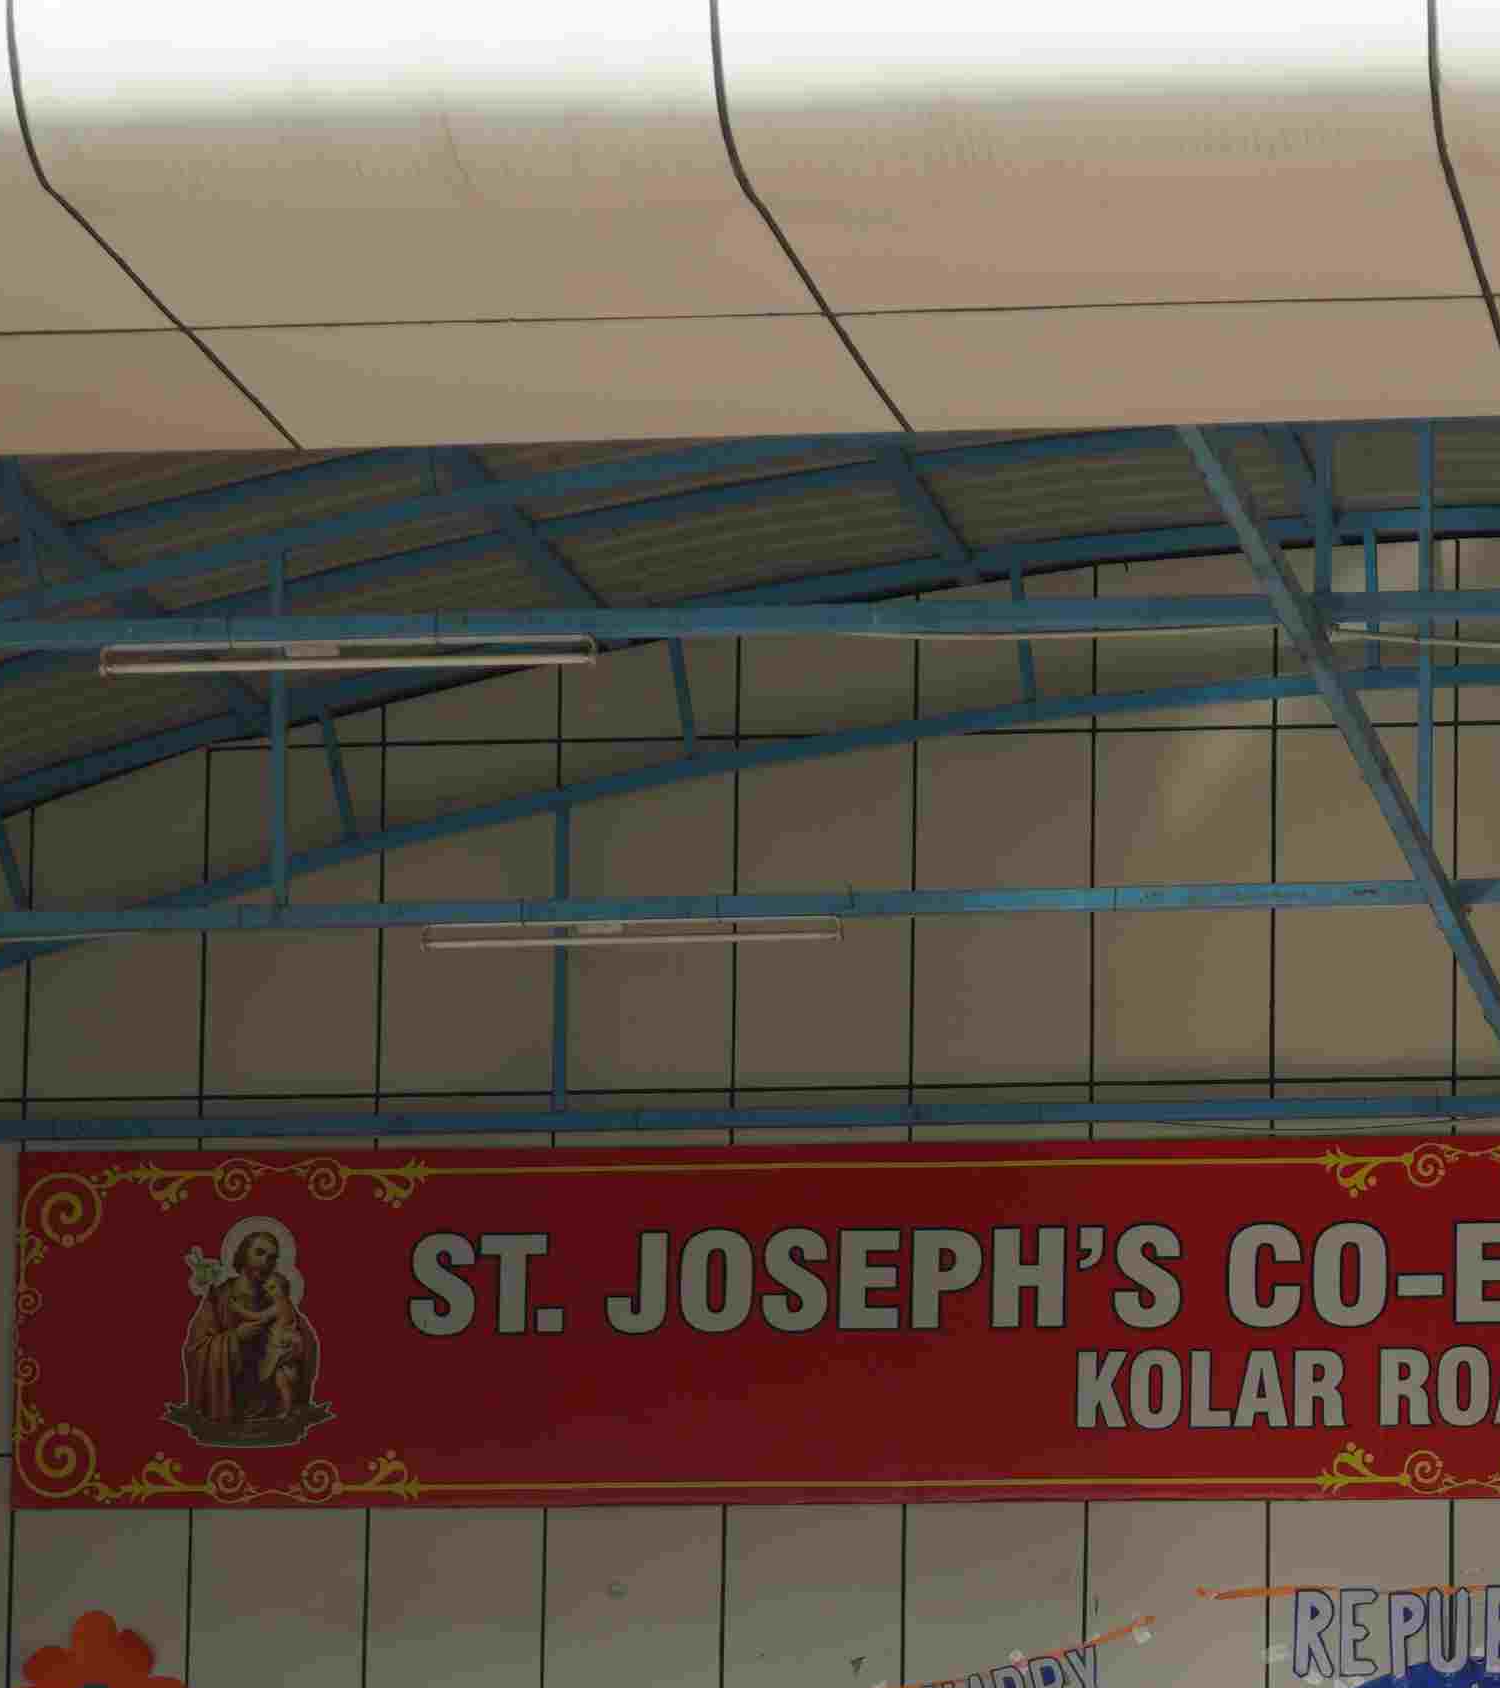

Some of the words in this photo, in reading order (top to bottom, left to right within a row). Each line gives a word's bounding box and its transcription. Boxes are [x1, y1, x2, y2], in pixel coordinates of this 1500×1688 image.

[407, 1229, 566, 1336] ST.
[604, 1221, 1184, 1335] JOSEPH'S
[1074, 1347, 1349, 1431] KOLAR
